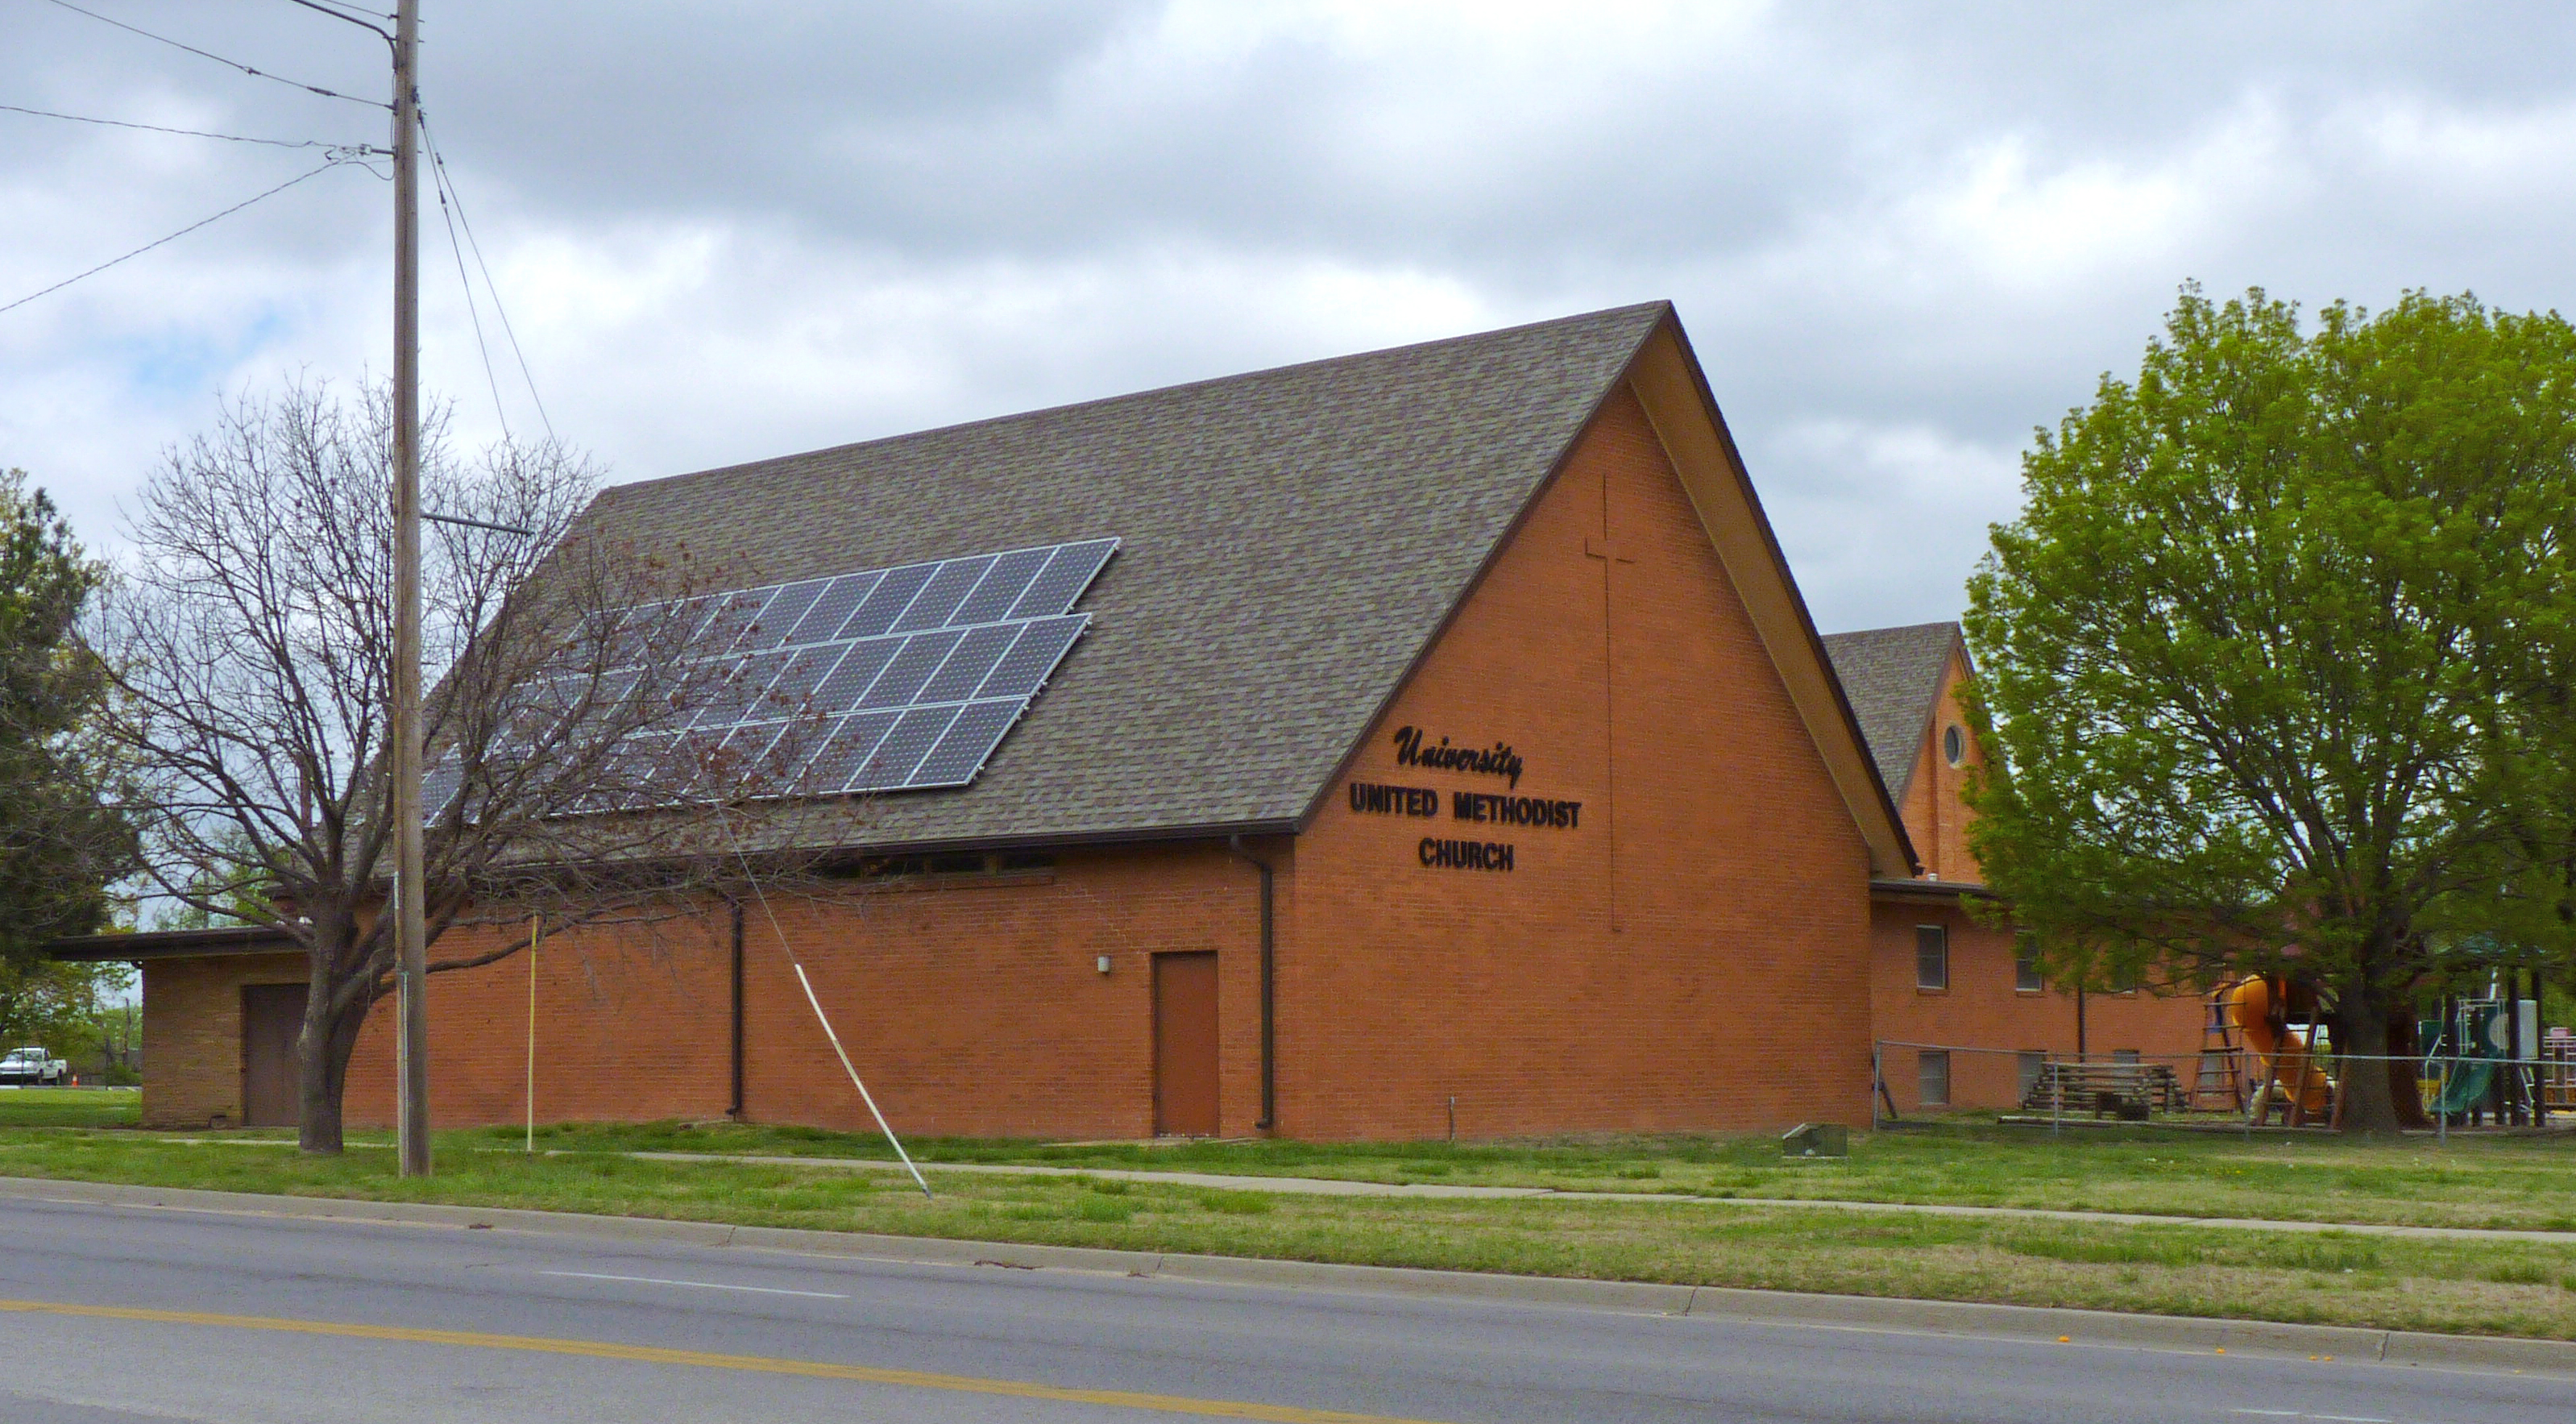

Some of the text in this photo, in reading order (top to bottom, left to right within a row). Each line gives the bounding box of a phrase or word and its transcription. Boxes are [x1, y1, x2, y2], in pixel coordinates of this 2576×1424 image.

[1394, 726, 1523, 790] University
[1350, 783, 1582, 828] UNITED METHODIST
[1419, 837, 1514, 871] CHURCH
